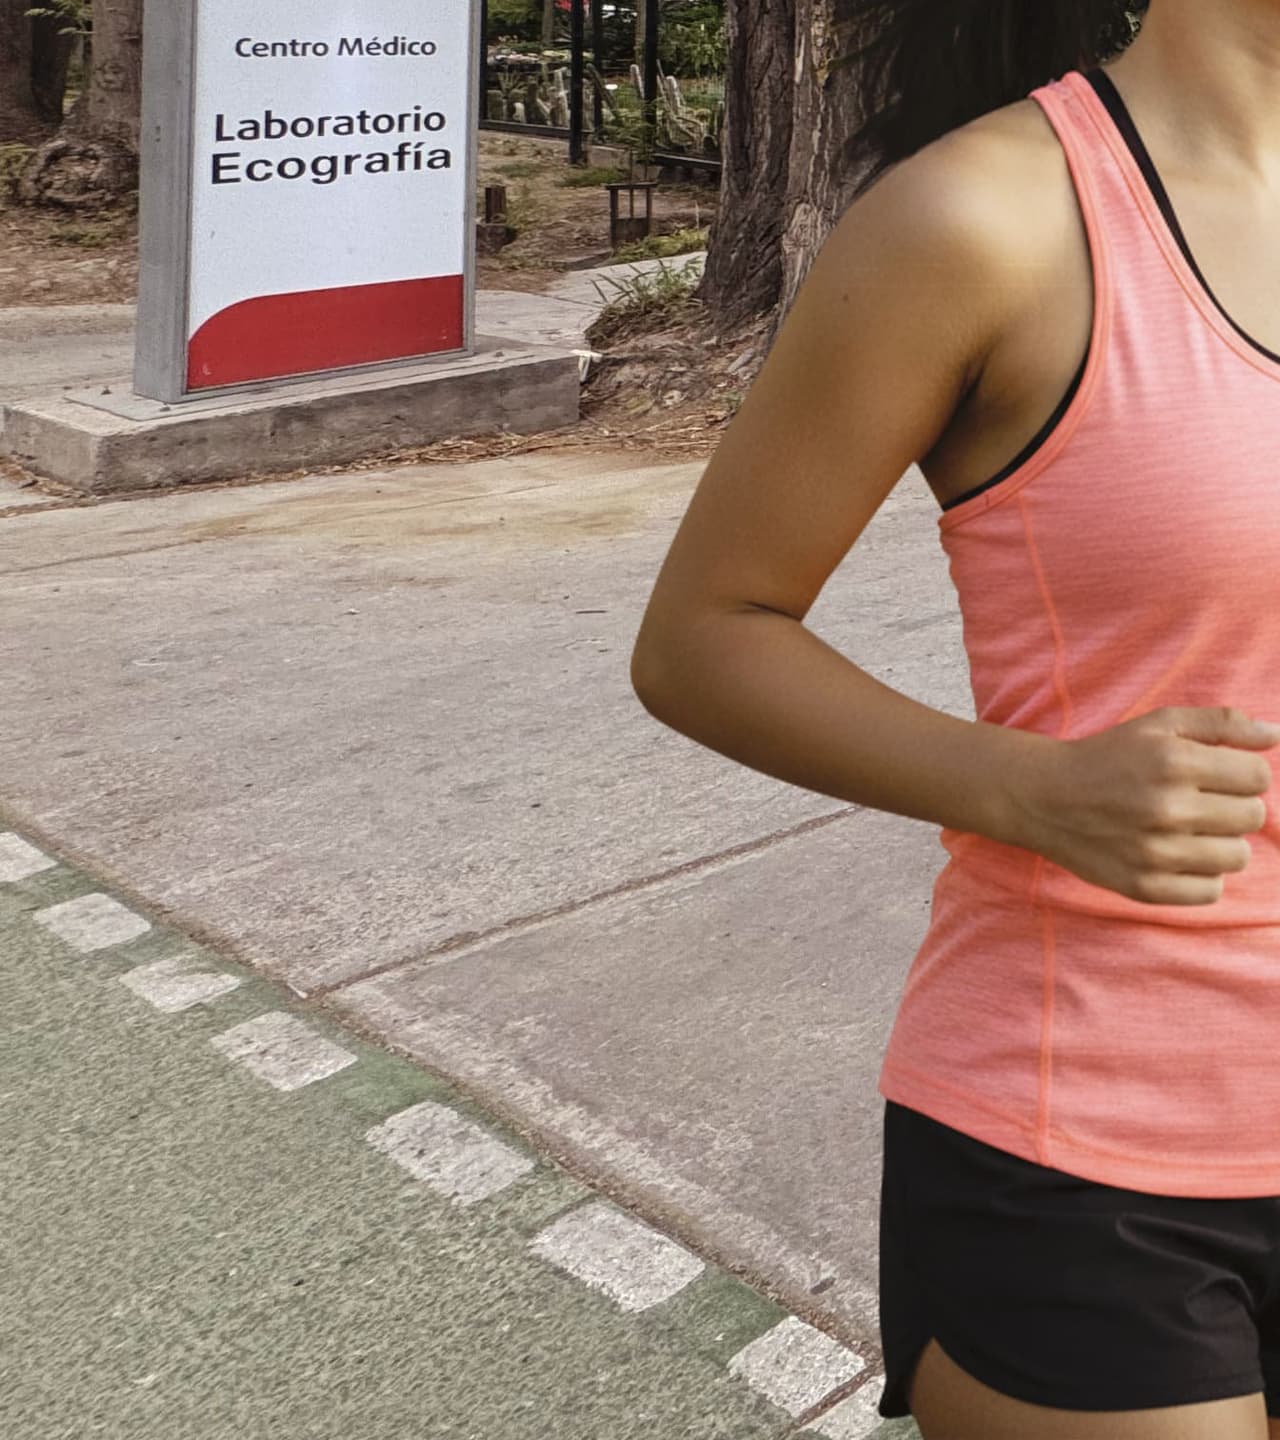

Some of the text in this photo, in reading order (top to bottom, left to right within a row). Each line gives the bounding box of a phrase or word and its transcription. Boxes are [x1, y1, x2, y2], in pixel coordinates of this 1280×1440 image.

[234, 35, 438, 58] Centro Médico
[215, 104, 447, 143] Laboratorio
[211, 141, 452, 185] Ecografía
